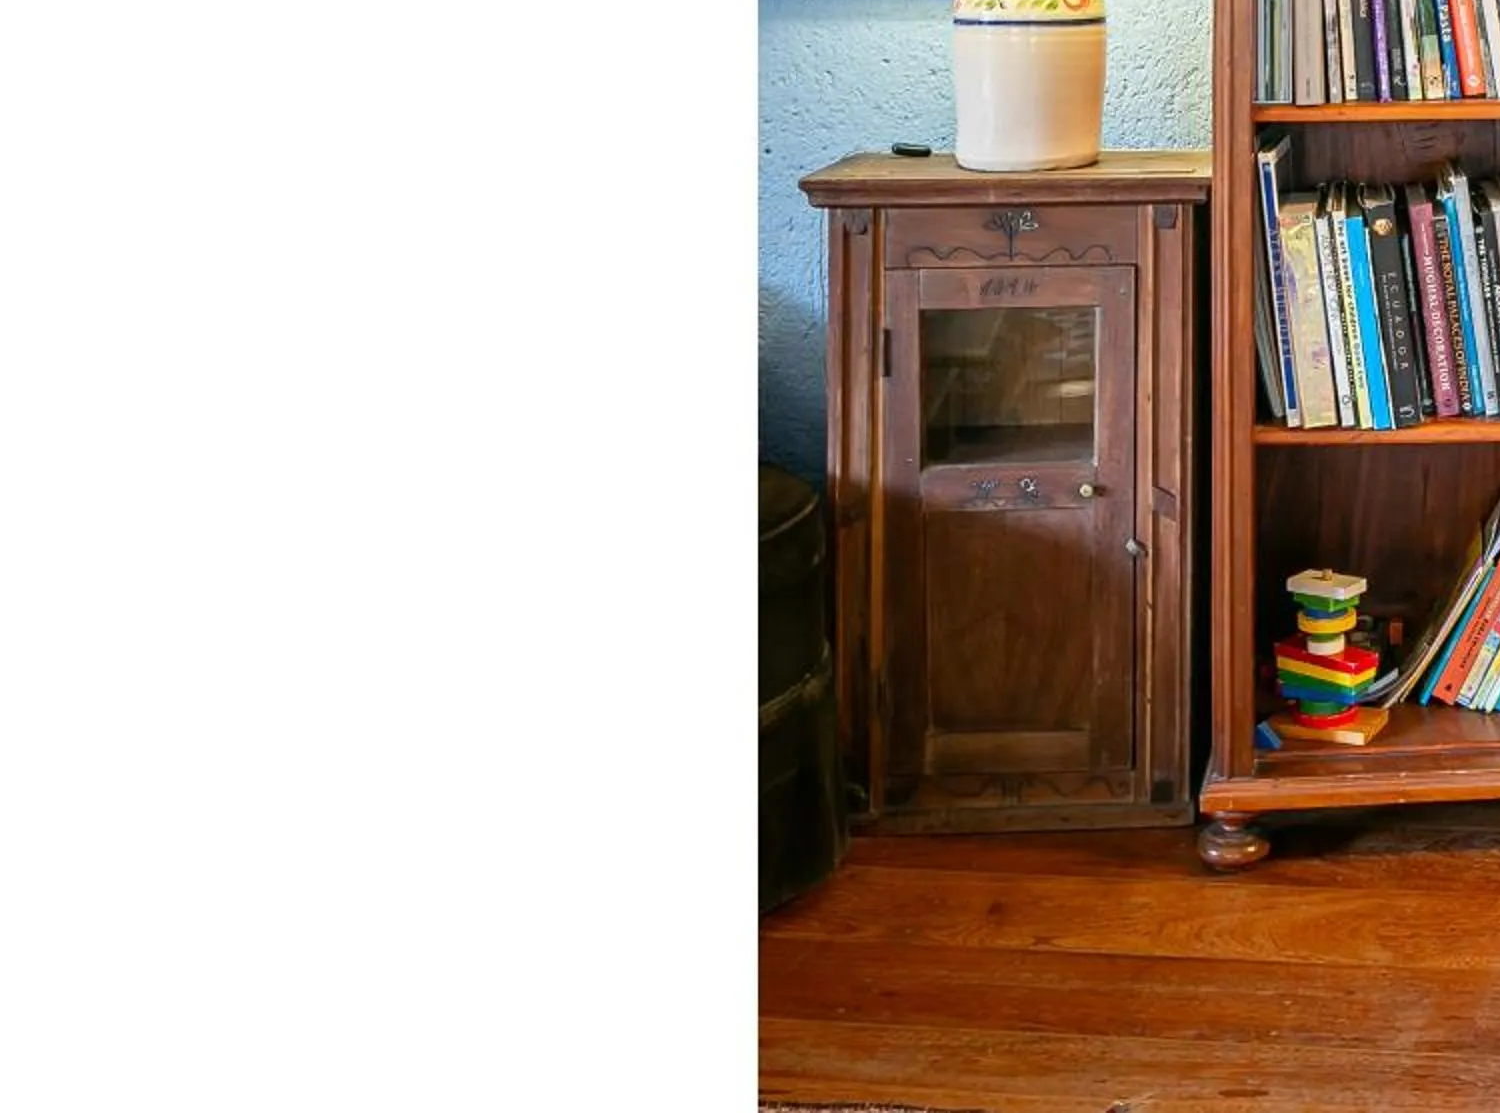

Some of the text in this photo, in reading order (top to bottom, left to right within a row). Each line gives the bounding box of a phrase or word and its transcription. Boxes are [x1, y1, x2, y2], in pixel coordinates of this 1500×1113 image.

[1424, 256, 1439, 308] MUGHAL
[1441, 262, 1455, 297] ROYAL
[1447, 300, 1464, 350] PALACES
[1431, 311, 1449, 391] DECORATION
[1457, 367, 1470, 399] INDIA
